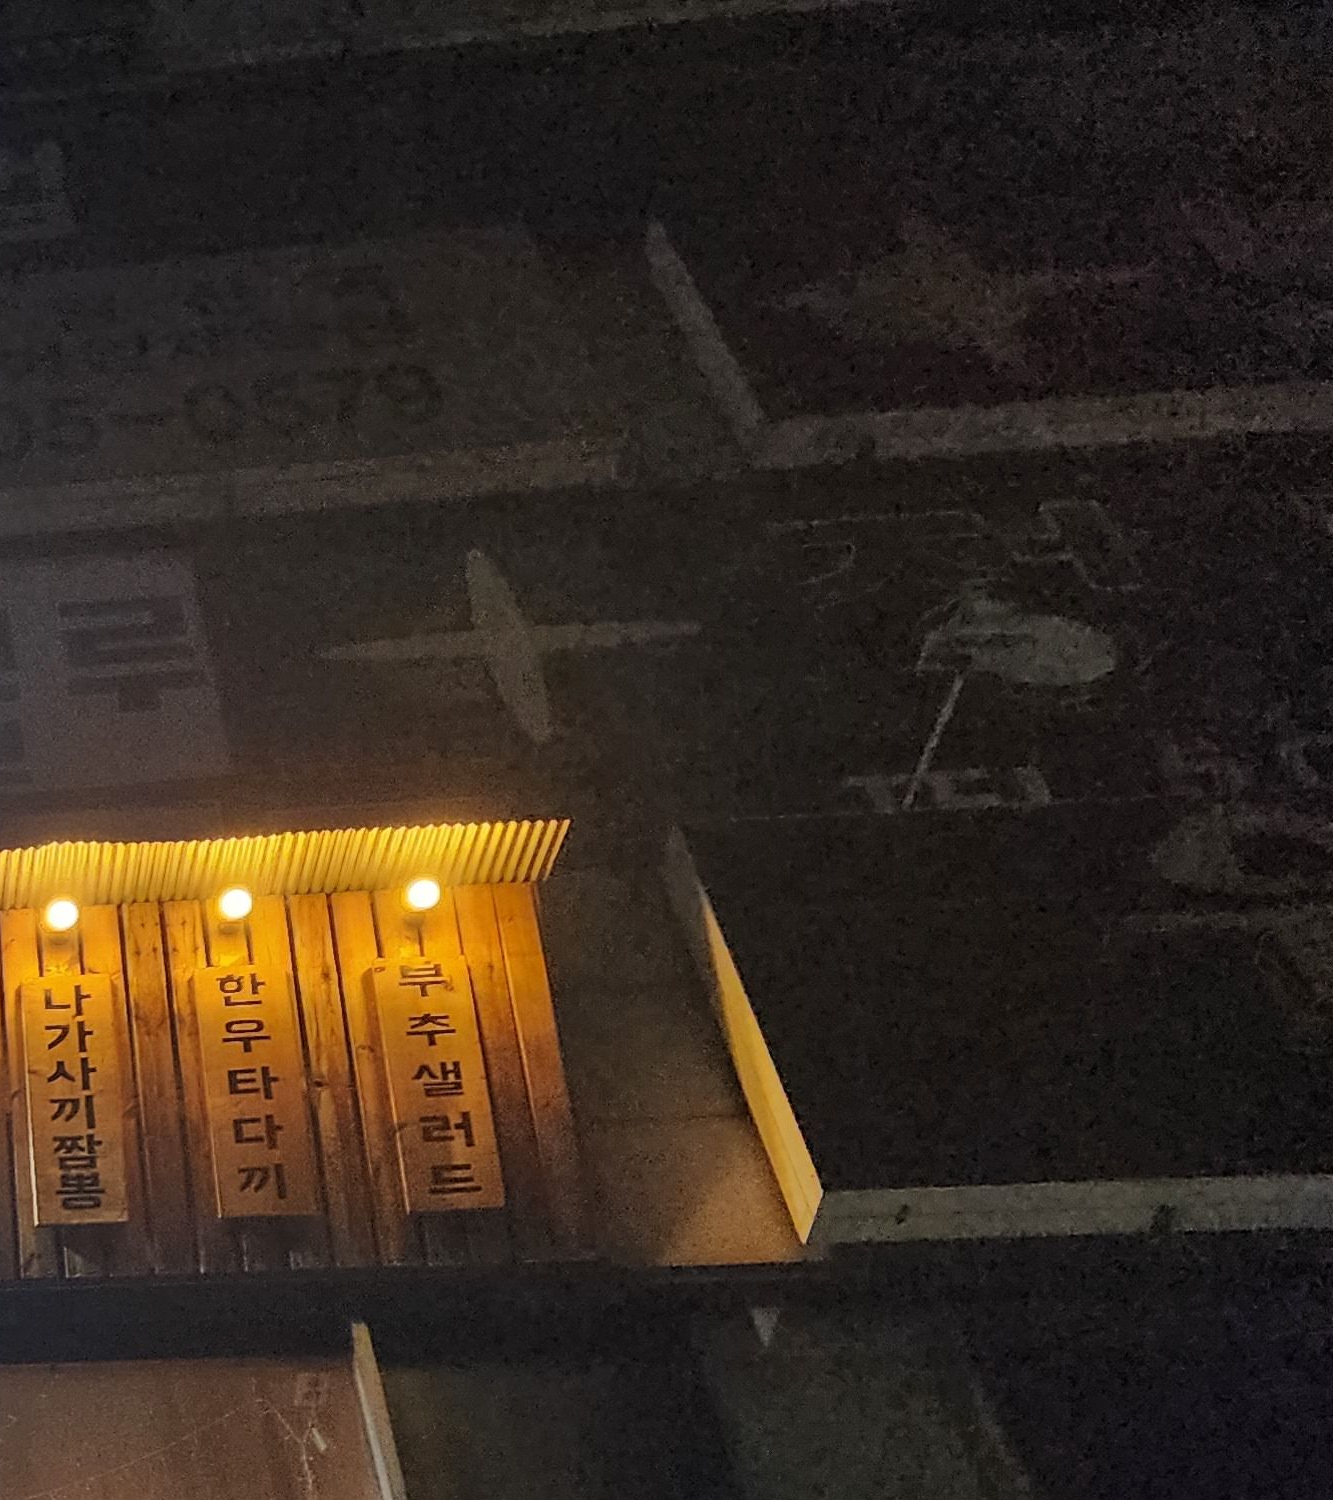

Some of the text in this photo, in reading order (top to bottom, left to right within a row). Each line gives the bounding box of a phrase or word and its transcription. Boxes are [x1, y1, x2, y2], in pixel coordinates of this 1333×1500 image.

[43, 984, 106, 1212] 나가사끼짬뽕
[215, 971, 288, 1201] 한우타다끼
[397, 962, 482, 1197] 부추샐러드
